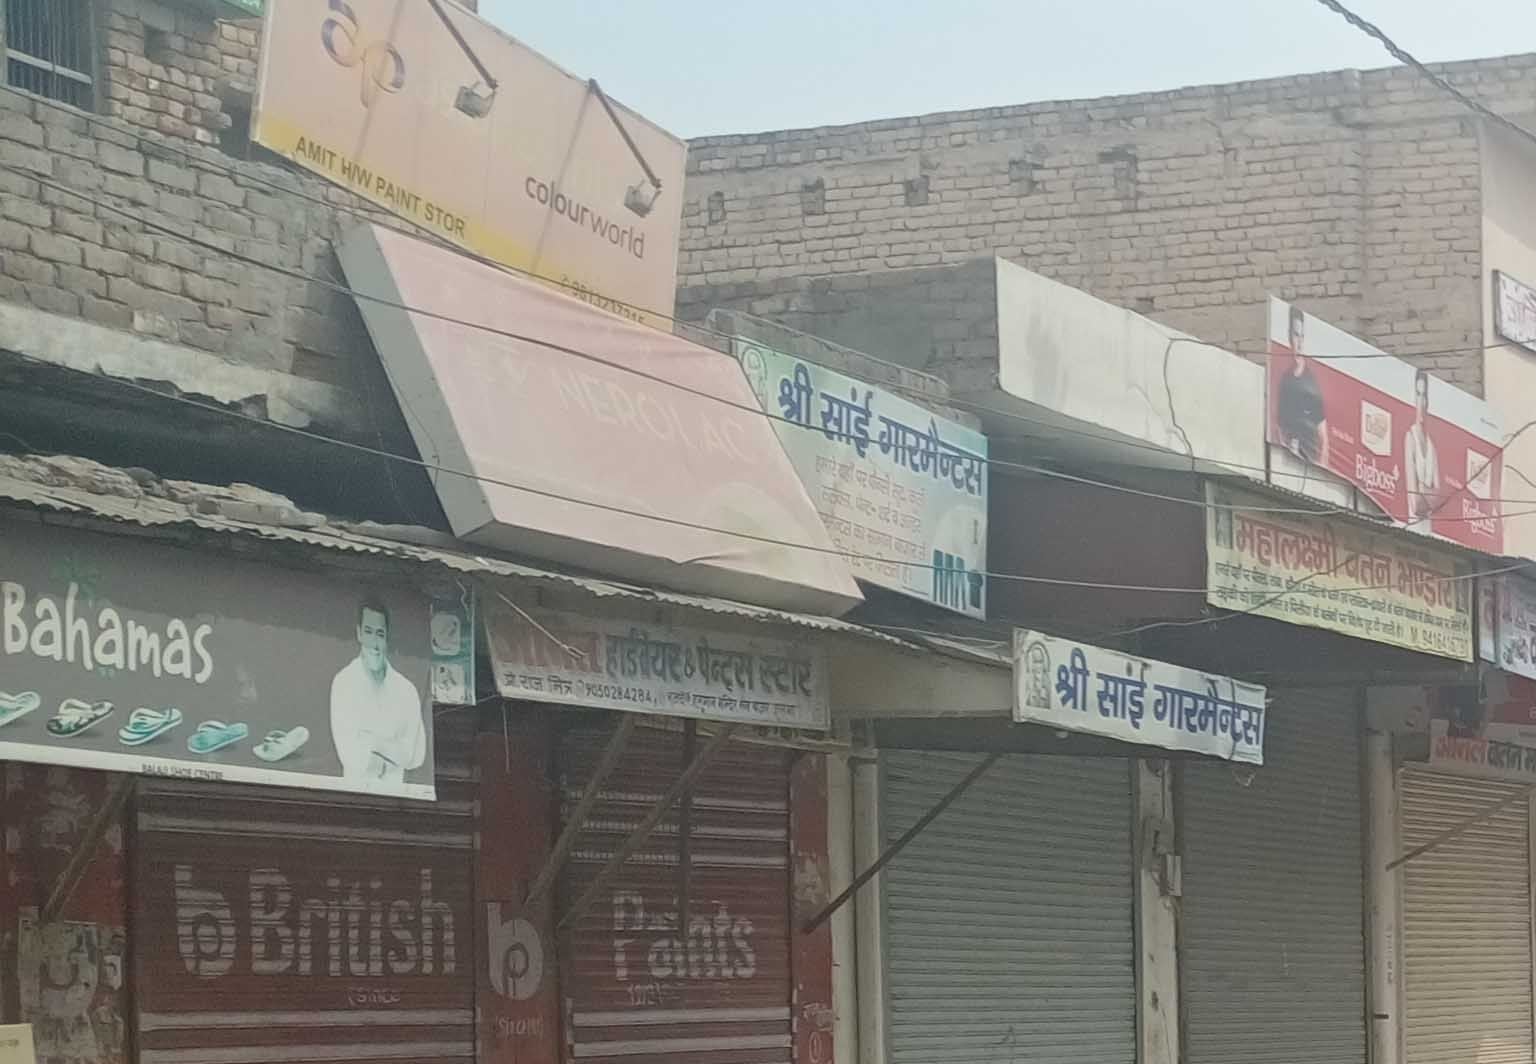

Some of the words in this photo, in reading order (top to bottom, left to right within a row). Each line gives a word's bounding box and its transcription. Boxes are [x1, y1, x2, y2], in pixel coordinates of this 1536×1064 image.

[295, 136, 337, 172] AMIT
[375, 176, 421, 217] PAINT
[424, 202, 466, 239] STOR
[525, 174, 646, 260] colourworld
[778, 362, 813, 428] श्री
[1, 581, 214, 684] Bahamas
[1055, 647, 1091, 713] श्री
[249, 867, 456, 978] British
[612, 889, 757, 982] Paints
